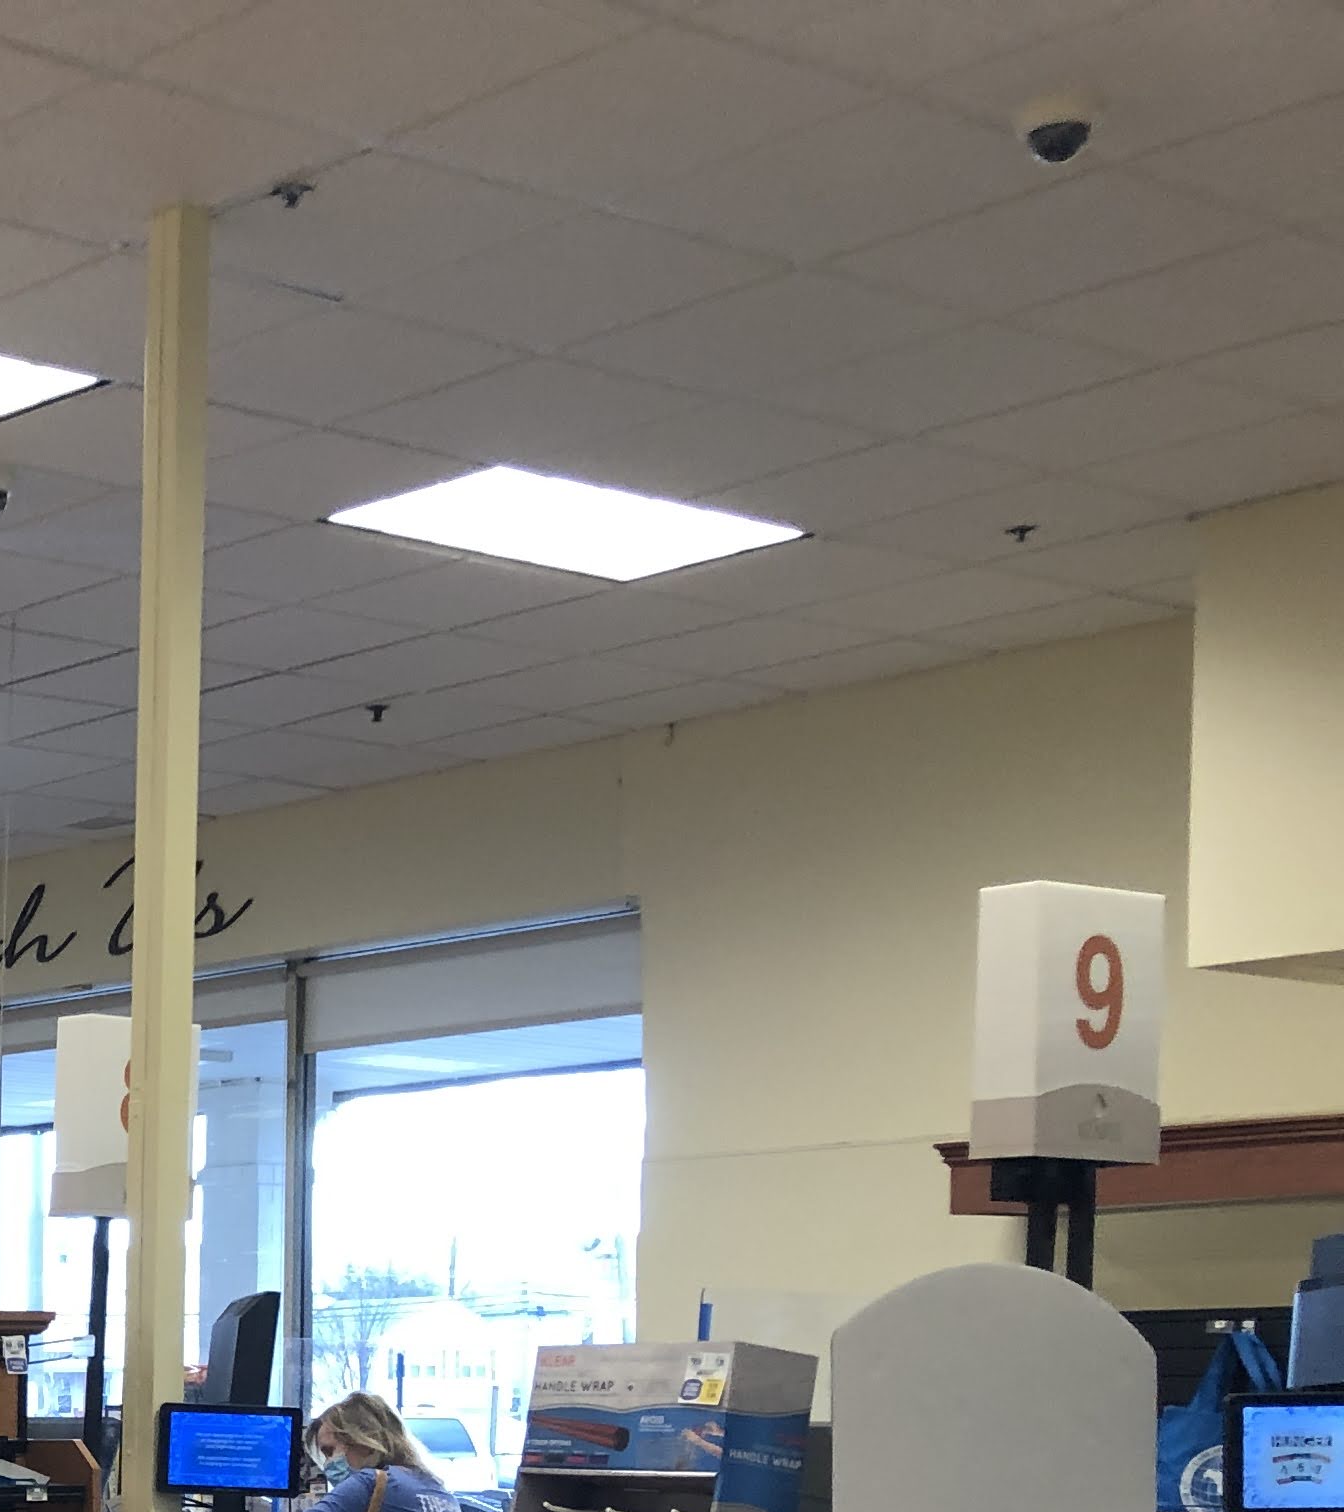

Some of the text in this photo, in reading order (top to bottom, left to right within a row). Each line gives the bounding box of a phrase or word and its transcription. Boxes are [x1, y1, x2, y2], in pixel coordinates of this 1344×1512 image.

[103, 854, 255, 957] s
[1075, 933, 1125, 1050] 9
[534, 1380, 615, 1393] HANDLE WRAP
[729, 1448, 803, 1470] HANDLE WRAP
